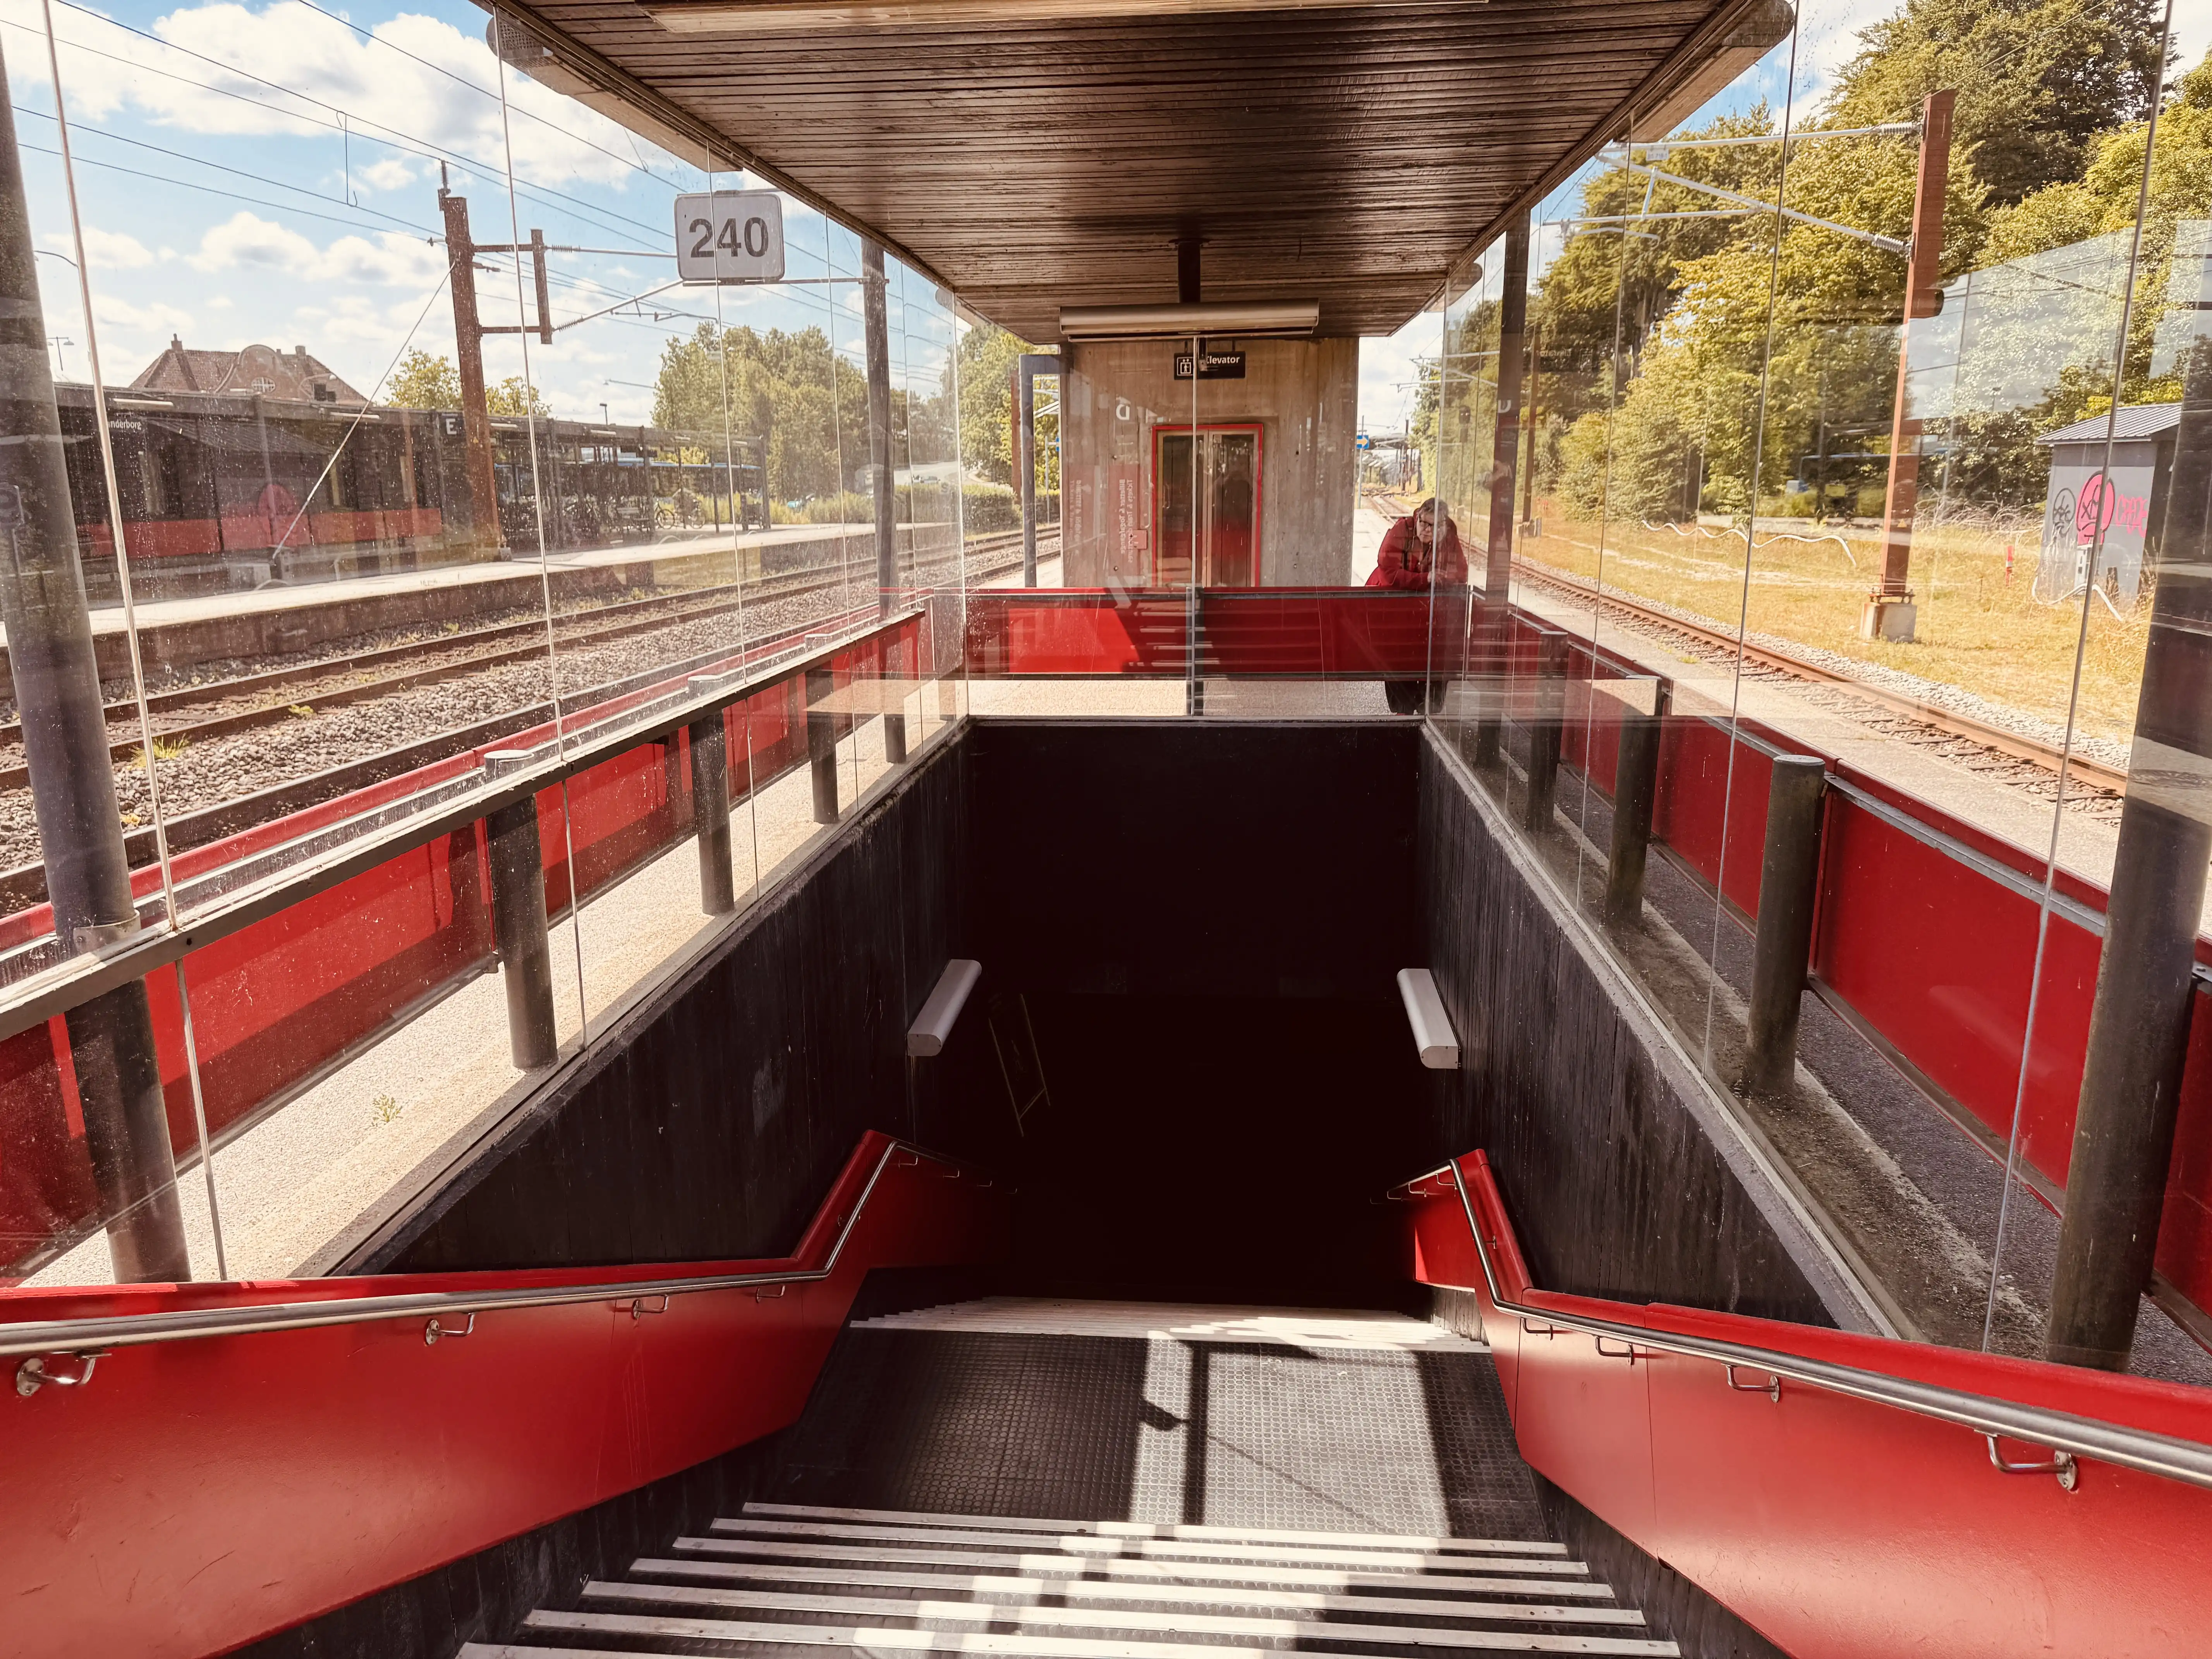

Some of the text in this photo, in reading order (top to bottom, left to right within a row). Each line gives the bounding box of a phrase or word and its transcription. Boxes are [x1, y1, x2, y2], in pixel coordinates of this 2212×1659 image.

[689, 216, 769, 258] 240
[108, 419, 142, 431] nderborg
[446, 418, 457, 435] E
